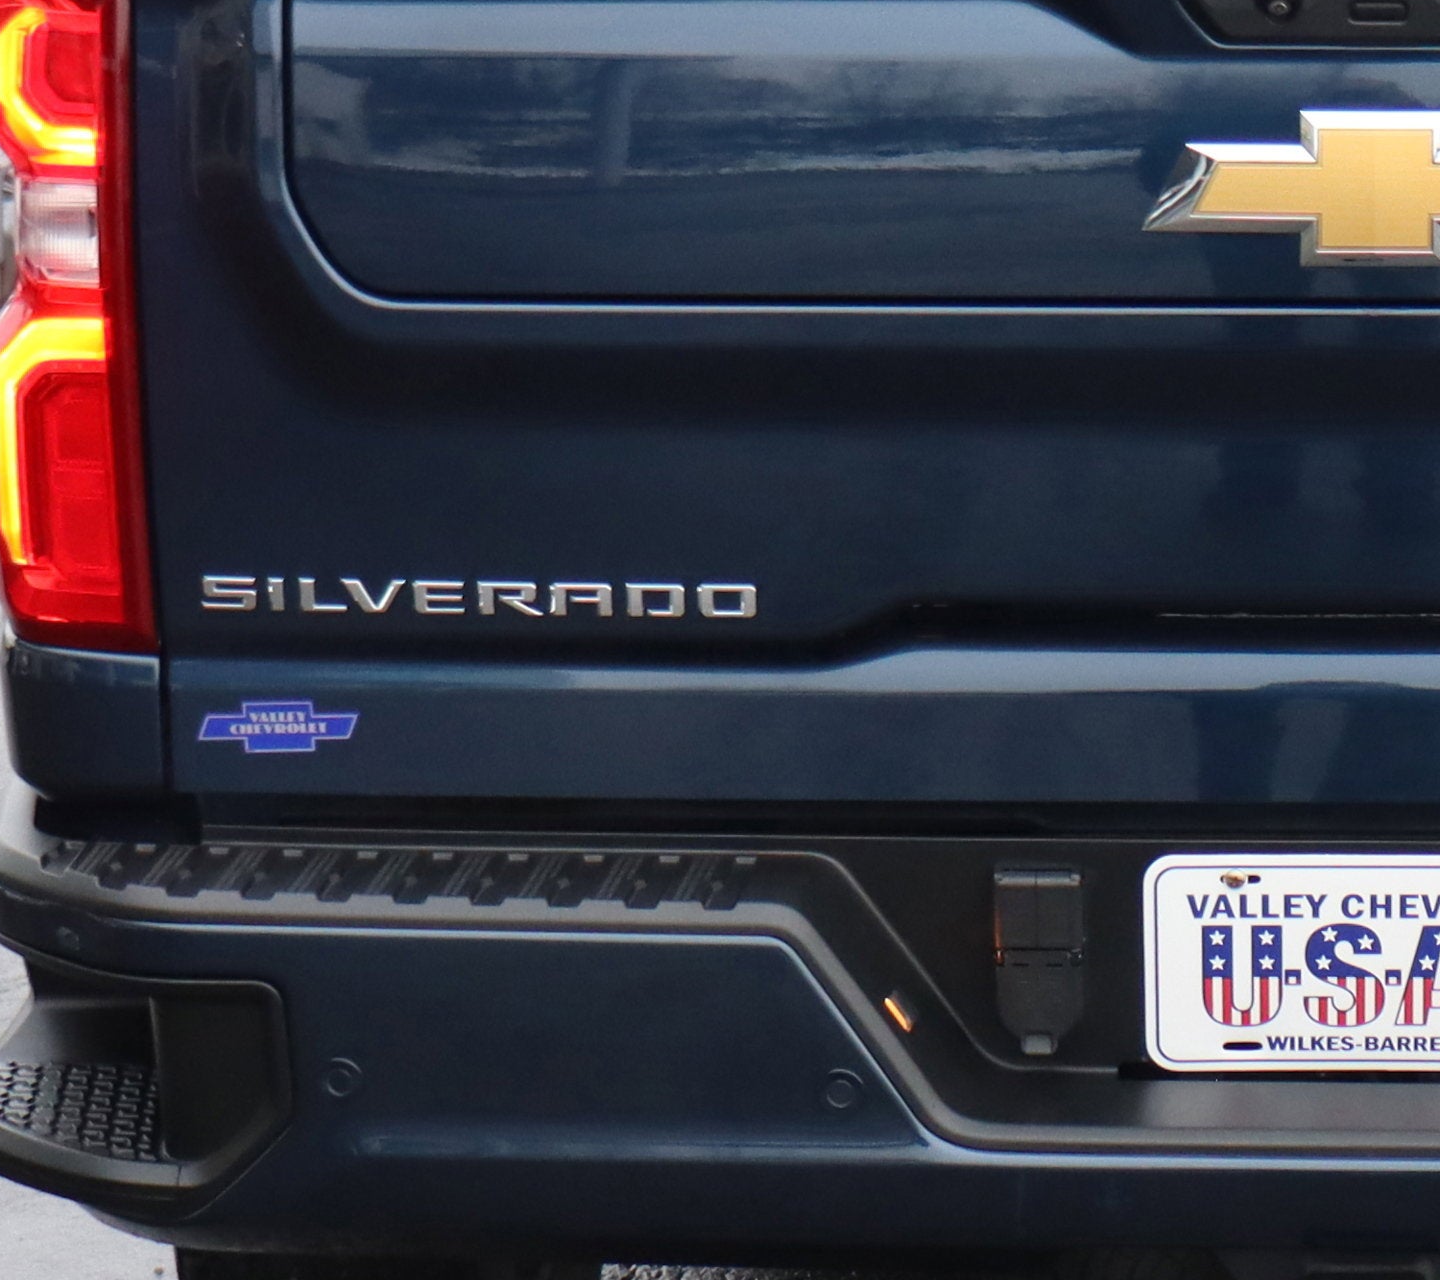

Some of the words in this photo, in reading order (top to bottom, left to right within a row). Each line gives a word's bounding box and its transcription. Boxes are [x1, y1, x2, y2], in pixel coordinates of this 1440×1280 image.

[201, 574, 757, 617] SILVERADO
[248, 711, 307, 723] VALLEY
[229, 722, 328, 735] CHEVROLET
[1186, 894, 1328, 920] VALLEY
